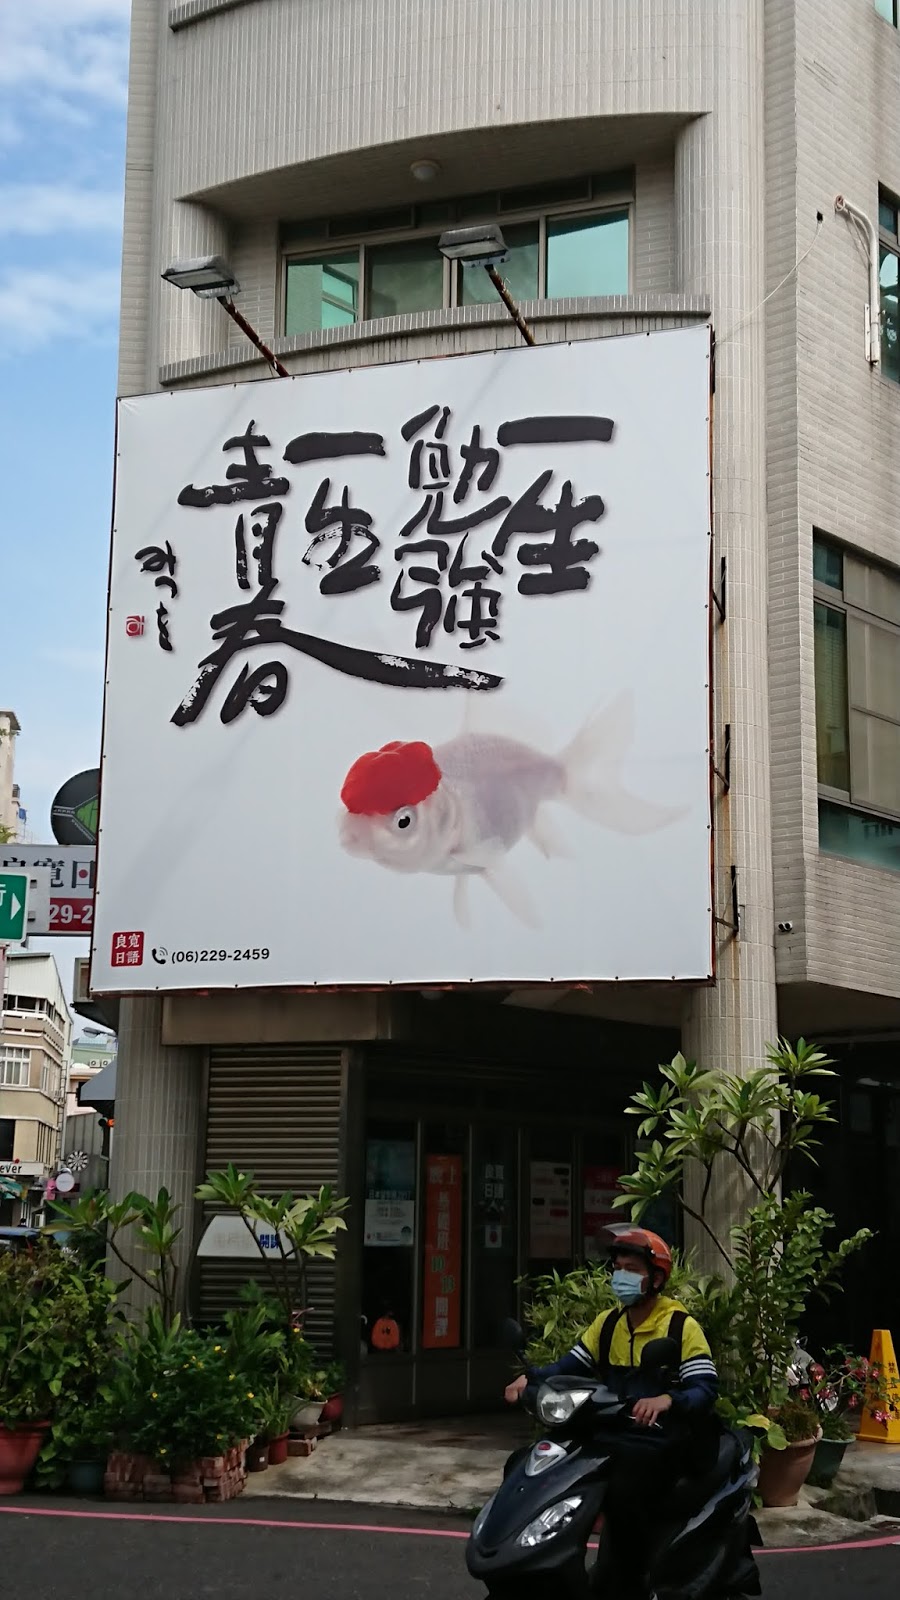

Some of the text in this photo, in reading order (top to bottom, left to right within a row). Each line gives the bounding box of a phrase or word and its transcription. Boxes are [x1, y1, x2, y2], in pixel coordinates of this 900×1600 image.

[493, 416, 615, 595] 一生
[170, 420, 504, 727] 青春
[50, 904, 93, 924] 29-2
[115, 950, 141, 965] 日語
[171, 948, 270, 965] (06)229-2459
